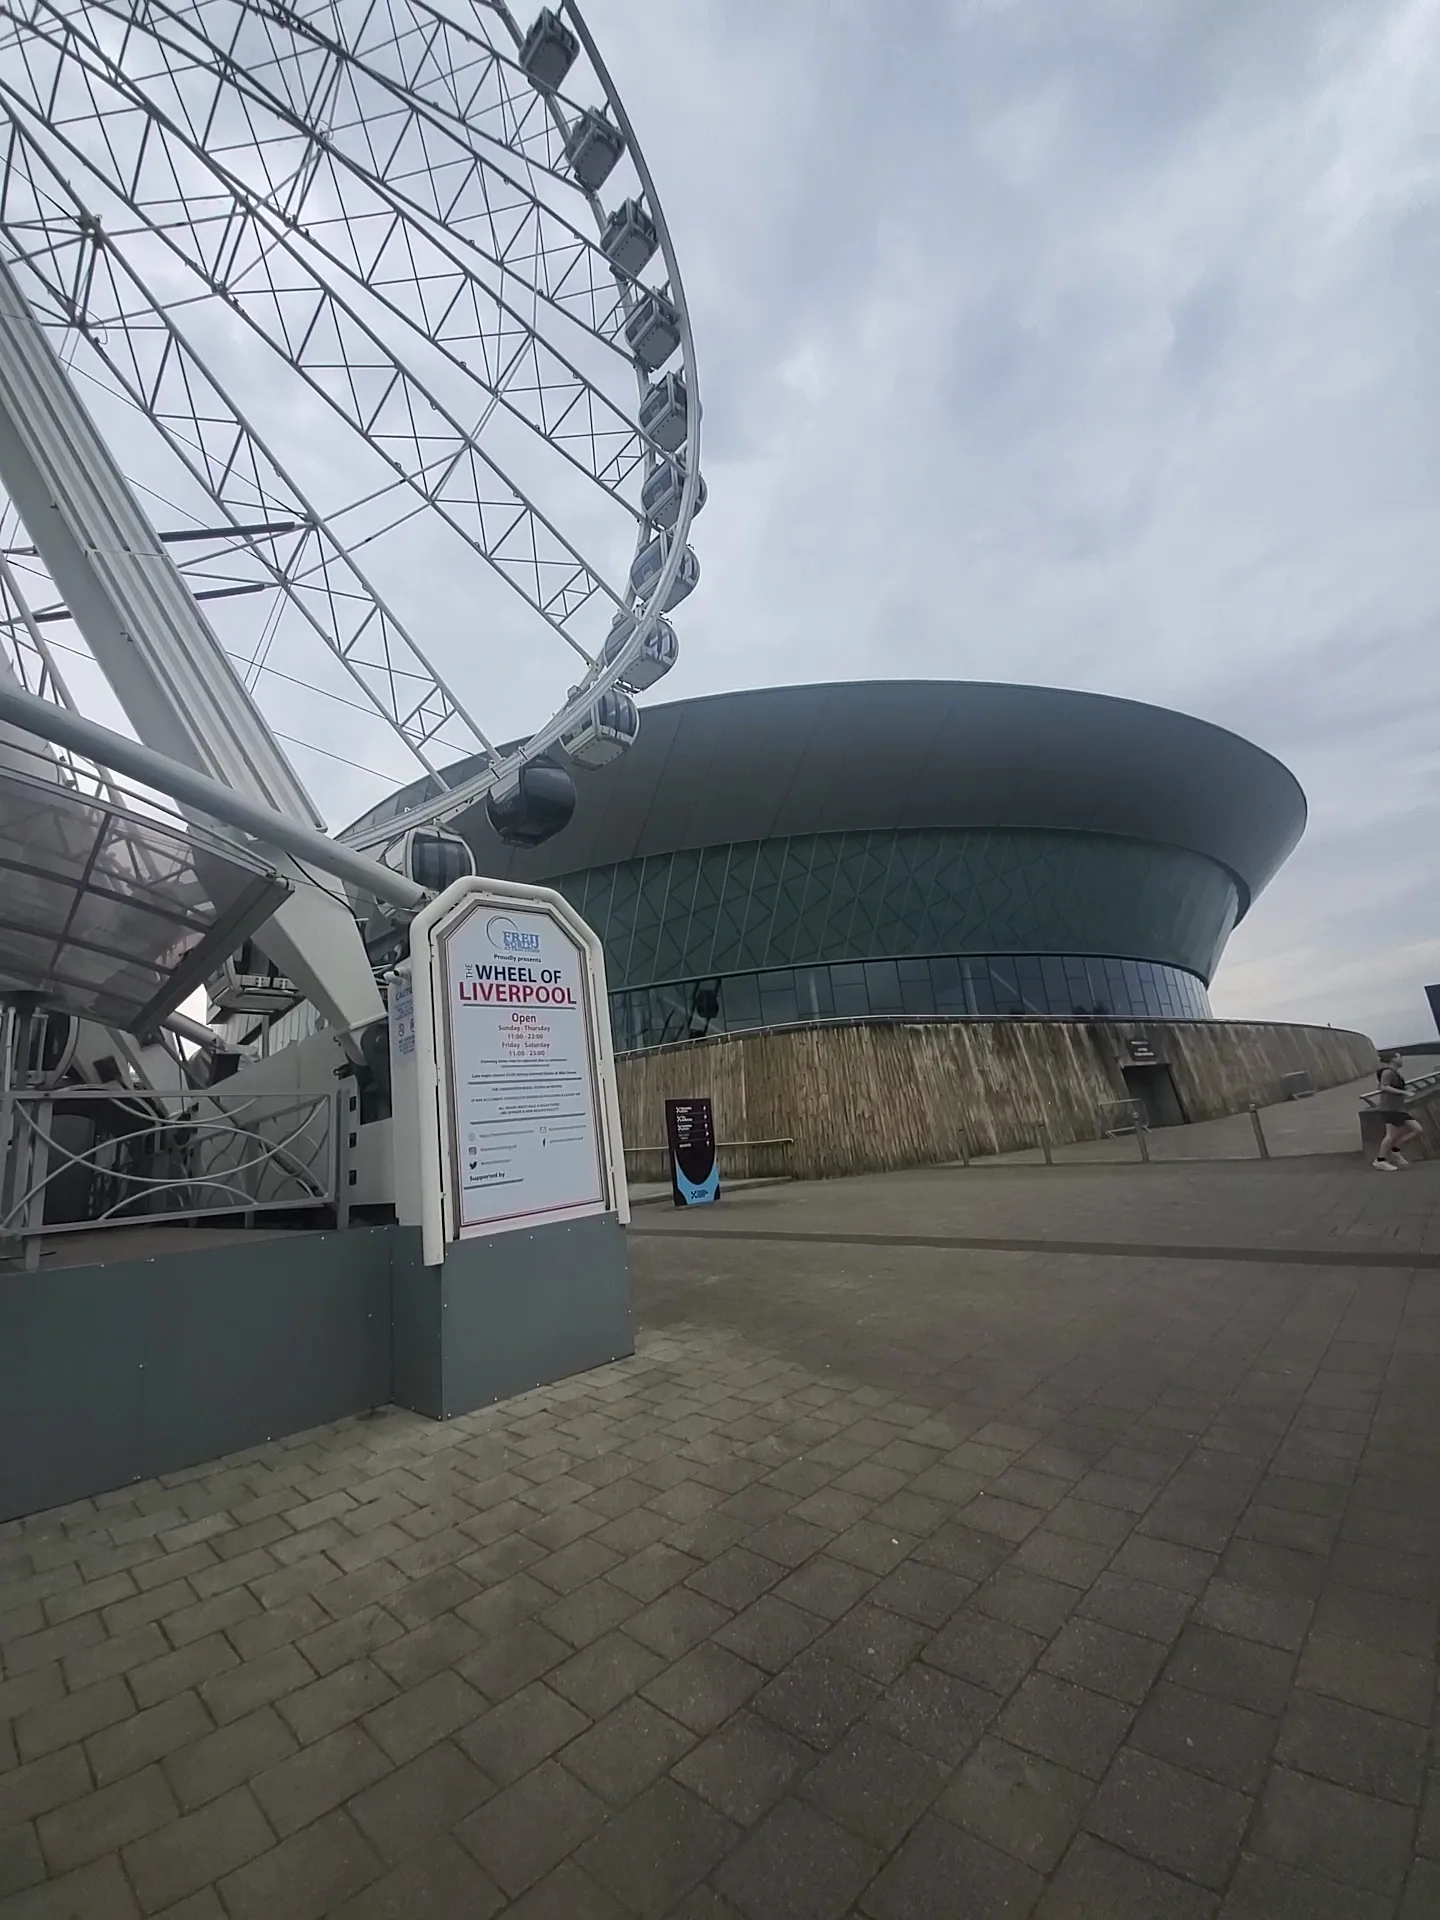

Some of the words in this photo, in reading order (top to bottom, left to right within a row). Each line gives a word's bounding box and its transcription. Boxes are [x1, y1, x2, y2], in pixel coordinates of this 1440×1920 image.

[494, 953, 517, 962] Proudly
[465, 963, 473, 979] THE
[475, 964, 537, 983] WHEEL
[541, 969, 562, 984] OF
[459, 981, 577, 1005] LIVERPOOL
[511, 1012, 537, 1025] Open
[469, 1172, 498, 1181] Supported
